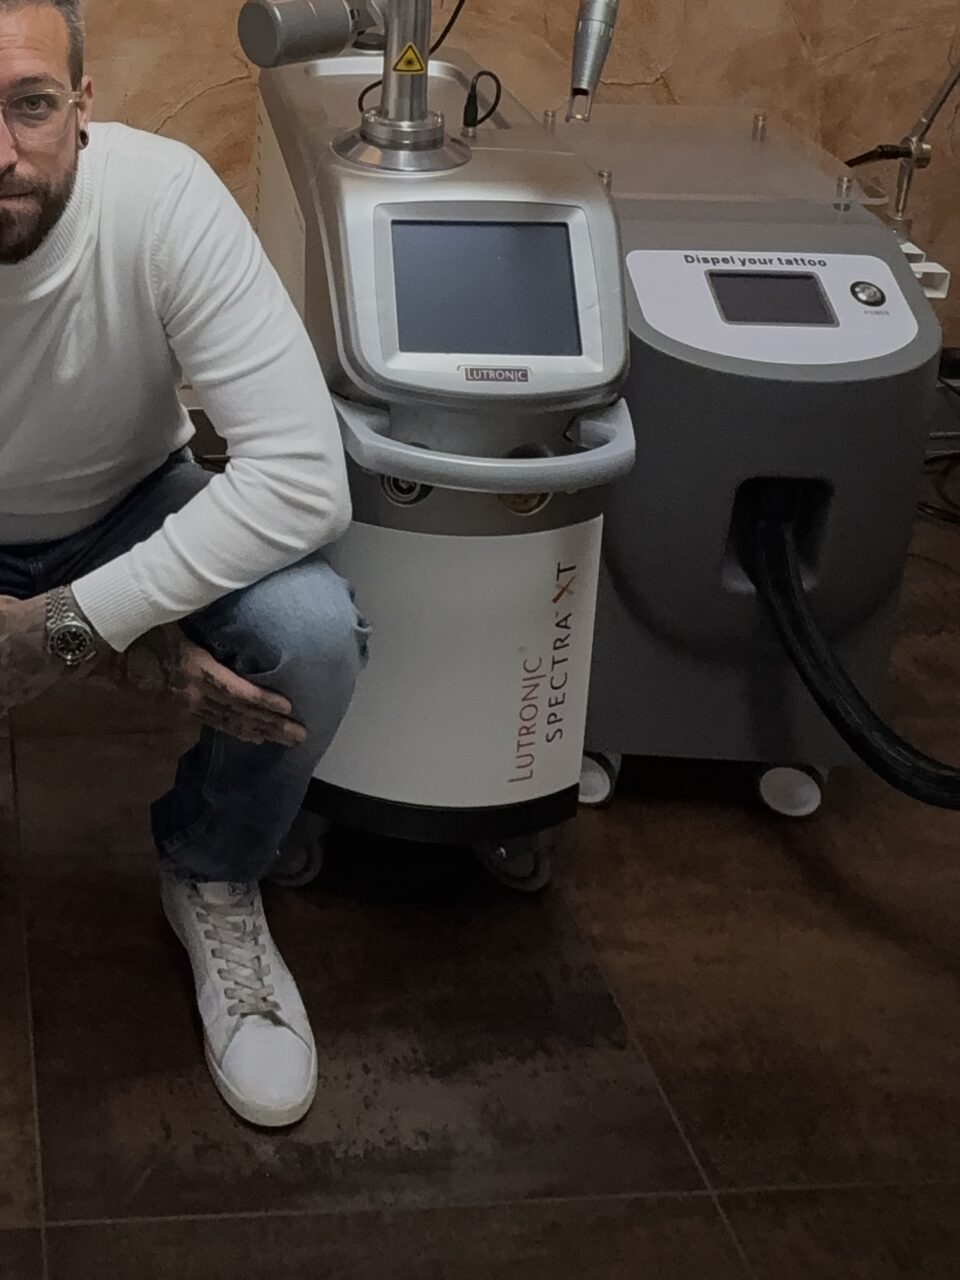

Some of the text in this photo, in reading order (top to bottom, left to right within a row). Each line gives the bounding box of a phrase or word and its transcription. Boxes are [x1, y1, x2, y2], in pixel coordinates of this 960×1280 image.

[683, 254, 828, 268] Dispel your tattoo
[467, 367, 528, 382] LUTRONIC
[546, 562, 577, 743] SPECTRA XT
[507, 656, 547, 783] LUTRONIC
